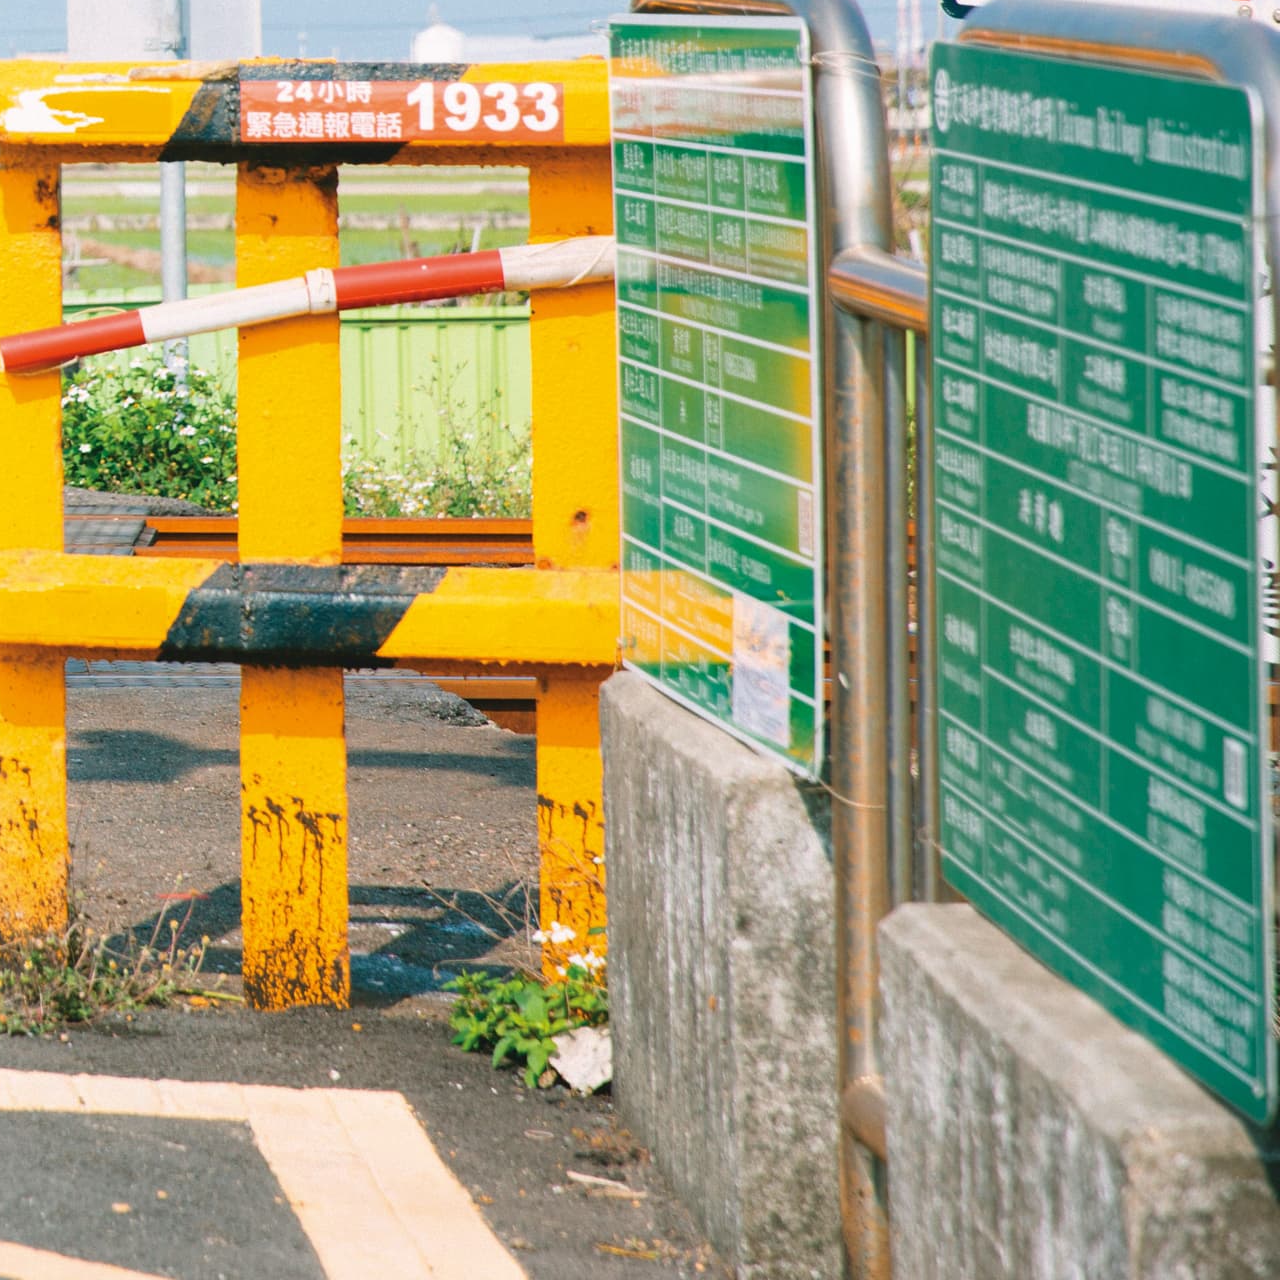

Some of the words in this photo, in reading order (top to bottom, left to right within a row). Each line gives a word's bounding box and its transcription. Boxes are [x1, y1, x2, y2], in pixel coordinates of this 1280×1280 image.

[276, 81, 372, 104] 24小時
[406, 82, 559, 132] 1933
[246, 111, 402, 139] 緊急通報電話
